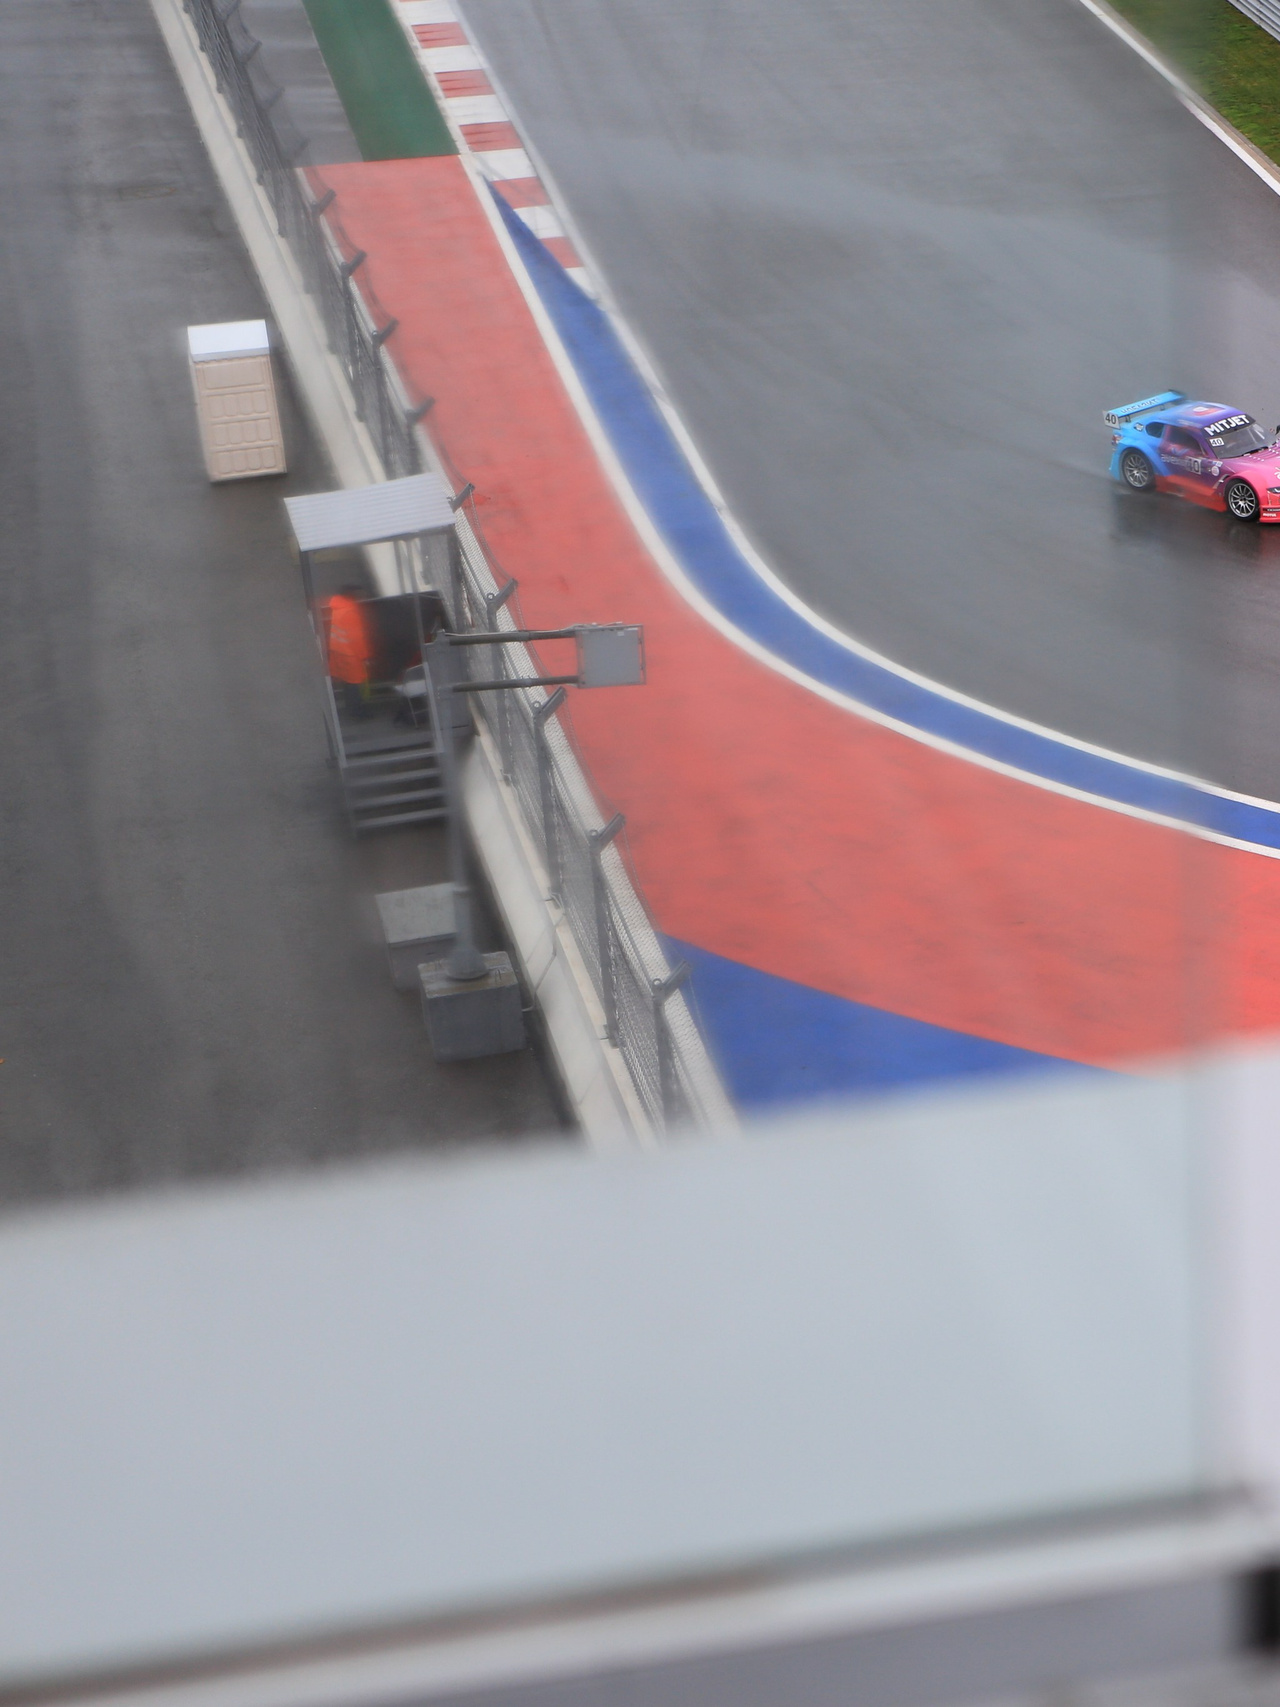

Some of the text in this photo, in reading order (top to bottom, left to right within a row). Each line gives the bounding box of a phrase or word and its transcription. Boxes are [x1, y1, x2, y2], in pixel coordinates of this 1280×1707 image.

[1105, 413, 1117, 424] 40
[1204, 414, 1250, 436] MITJET
[1211, 438, 1222, 446] 40
